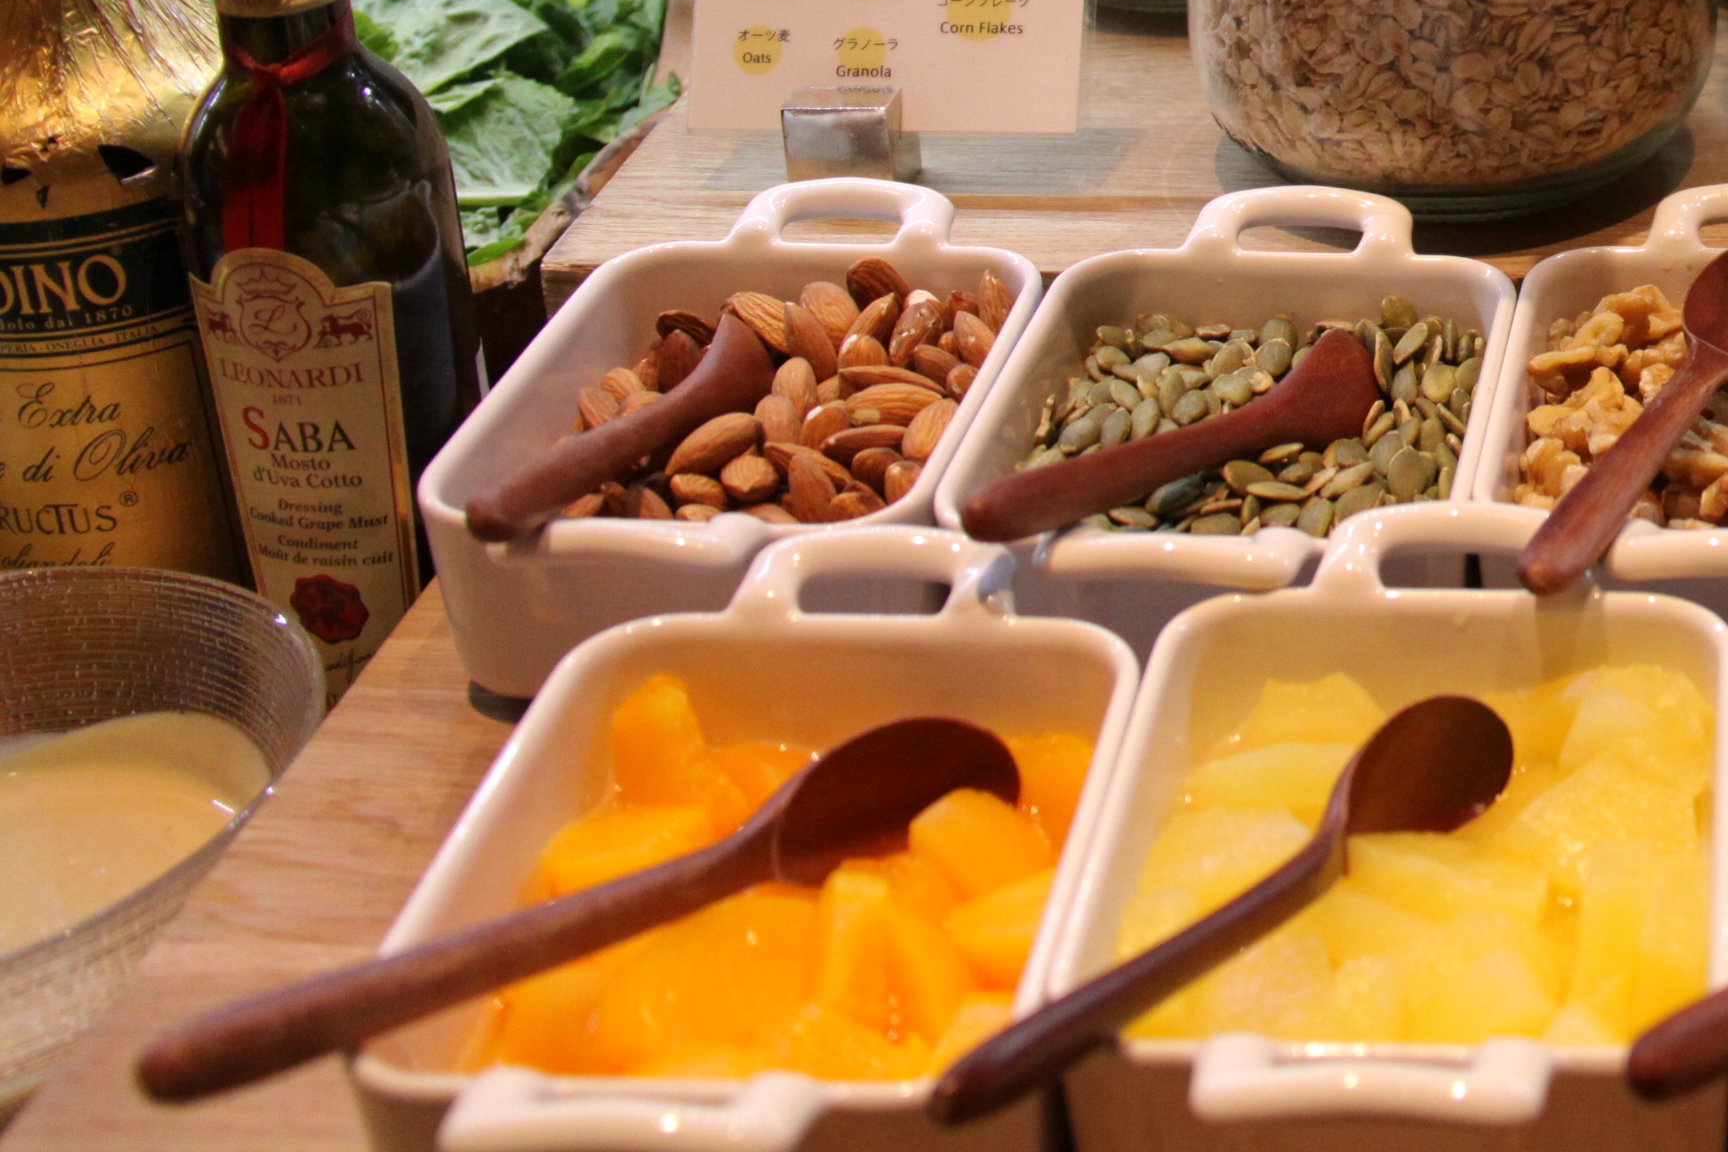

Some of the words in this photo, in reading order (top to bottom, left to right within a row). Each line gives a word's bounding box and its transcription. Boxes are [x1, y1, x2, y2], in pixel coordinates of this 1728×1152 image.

[738, 29, 790, 43] オーツ麦
[940, 21, 974, 35] Corn
[979, 21, 1024, 35] Flakes
[833, 37, 899, 51] グラノーラ
[742, 52, 772, 64] Oats
[836, 65, 892, 78] Granola
[84, 305, 133, 325] 1870
[220, 358, 366, 390] LEONARDI
[16, 382, 121, 429] Extra
[272, 394, 303, 407] 1871
[242, 406, 357, 453] SABA
[22, 446, 61, 482] di
[73, 426, 188, 482] Oliva
[270, 452, 331, 471] Mosto
[253, 466, 302, 488] d'Uva
[306, 472, 363, 489] Cotto
[278, 498, 343, 515] Dressing
[250, 506, 293, 527] Cooked
[298, 517, 343, 533] Grape
[348, 514, 389, 530] Must
[278, 534, 359, 551] Condiment
[293, 552, 308, 565] de
[312, 553, 358, 567] raisin
[362, 551, 394, 566] cuit
